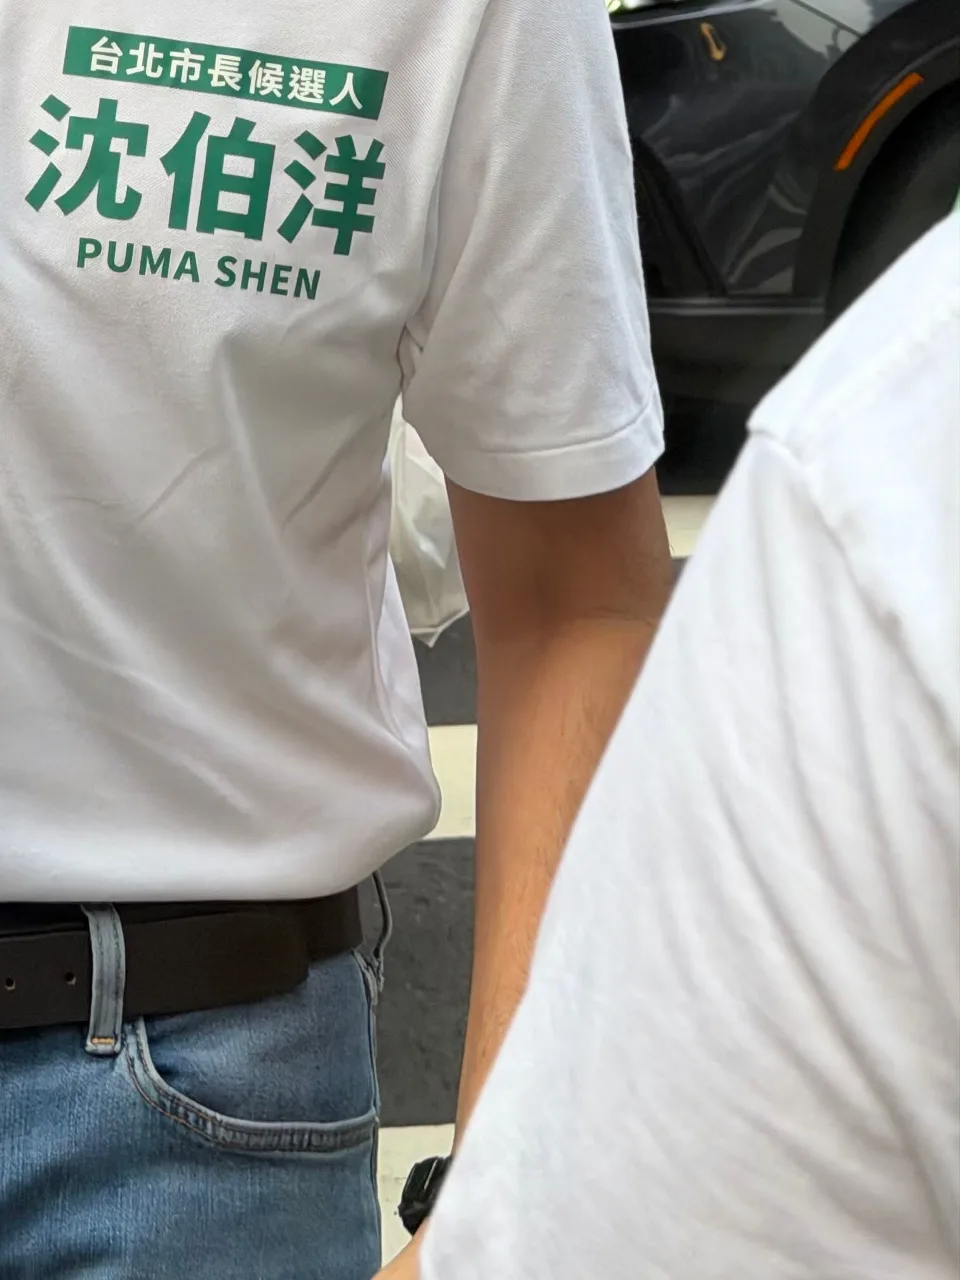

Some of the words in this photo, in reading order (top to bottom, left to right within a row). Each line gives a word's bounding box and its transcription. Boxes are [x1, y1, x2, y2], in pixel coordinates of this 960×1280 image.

[89, 36, 364, 110] 台北市長候選人
[24, 94, 387, 257] 沈伯洋
[77, 237, 201, 284] PUMA
[214, 255, 323, 301] SHEN
